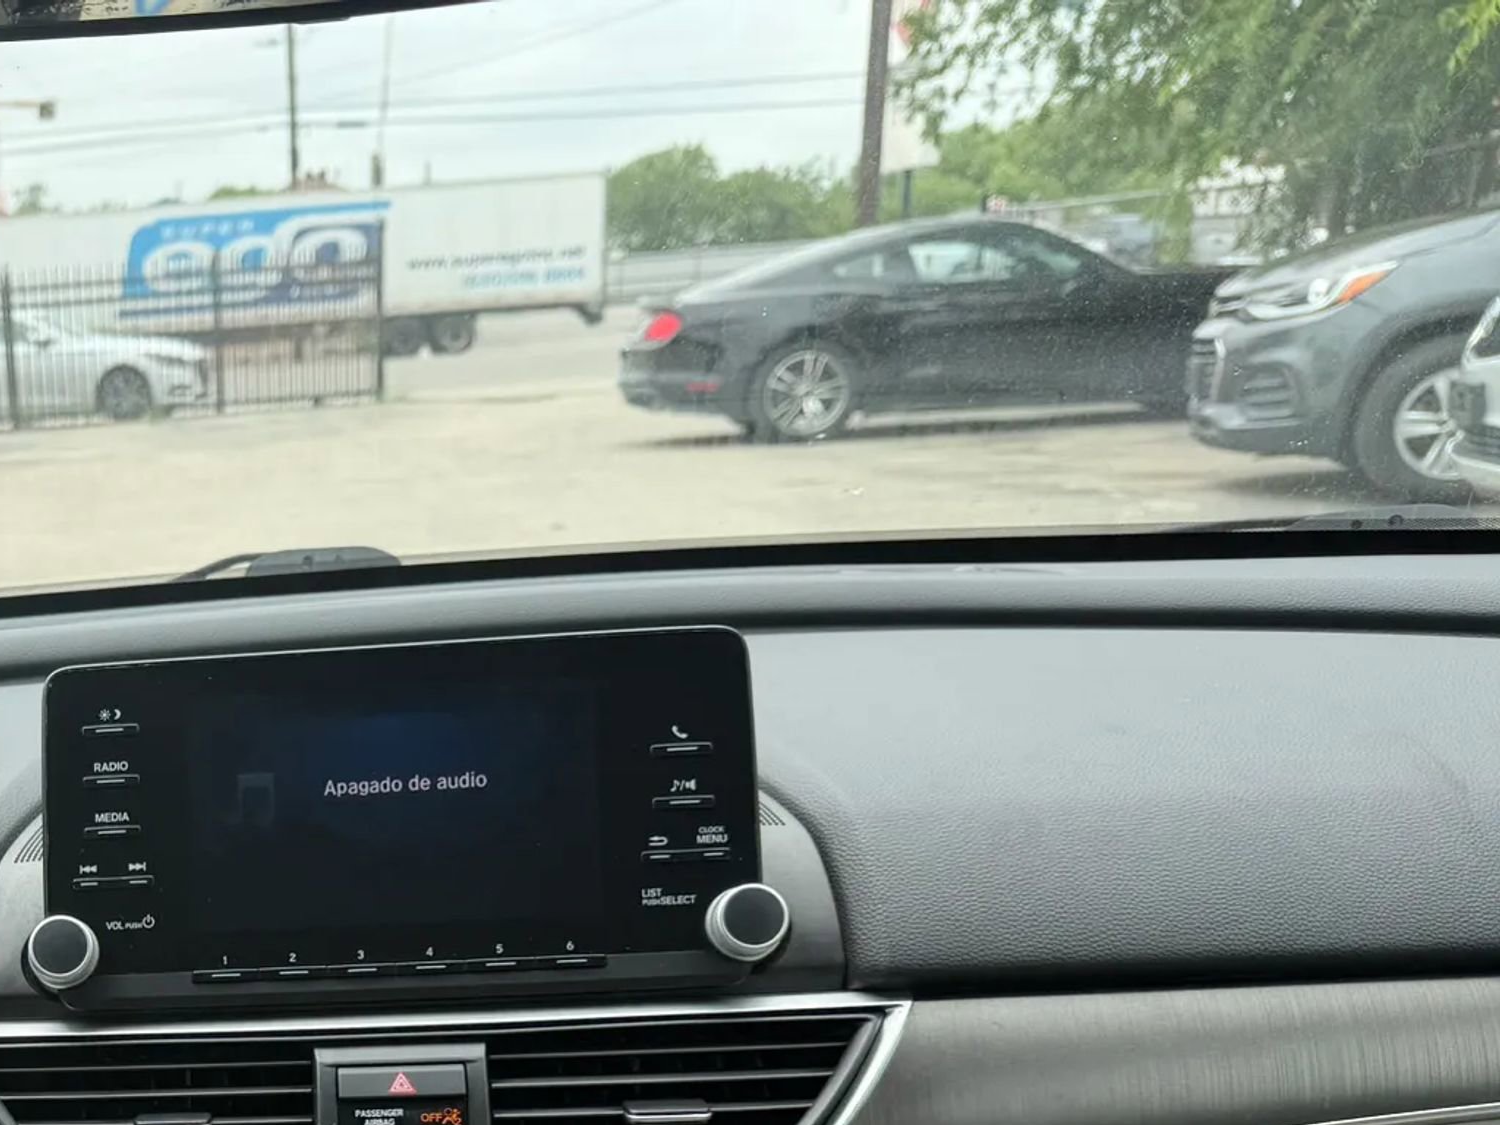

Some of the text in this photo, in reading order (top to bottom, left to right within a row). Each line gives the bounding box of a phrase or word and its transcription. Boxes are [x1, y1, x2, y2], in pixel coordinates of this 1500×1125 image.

[93, 761, 129, 772] RADIO
[324, 771, 488, 797] Apagado de audio
[95, 812, 130, 823] MEDIA
[696, 834, 728, 843] MENU
[642, 888, 662, 898] LIST
[660, 895, 697, 905] SELECT
[106, 921, 124, 930] VOL
[222, 940, 575, 965] 1 2 3 4 5 6
[354, 1108, 404, 1117] PASSENGER
[420, 1113, 442, 1122] OFF
